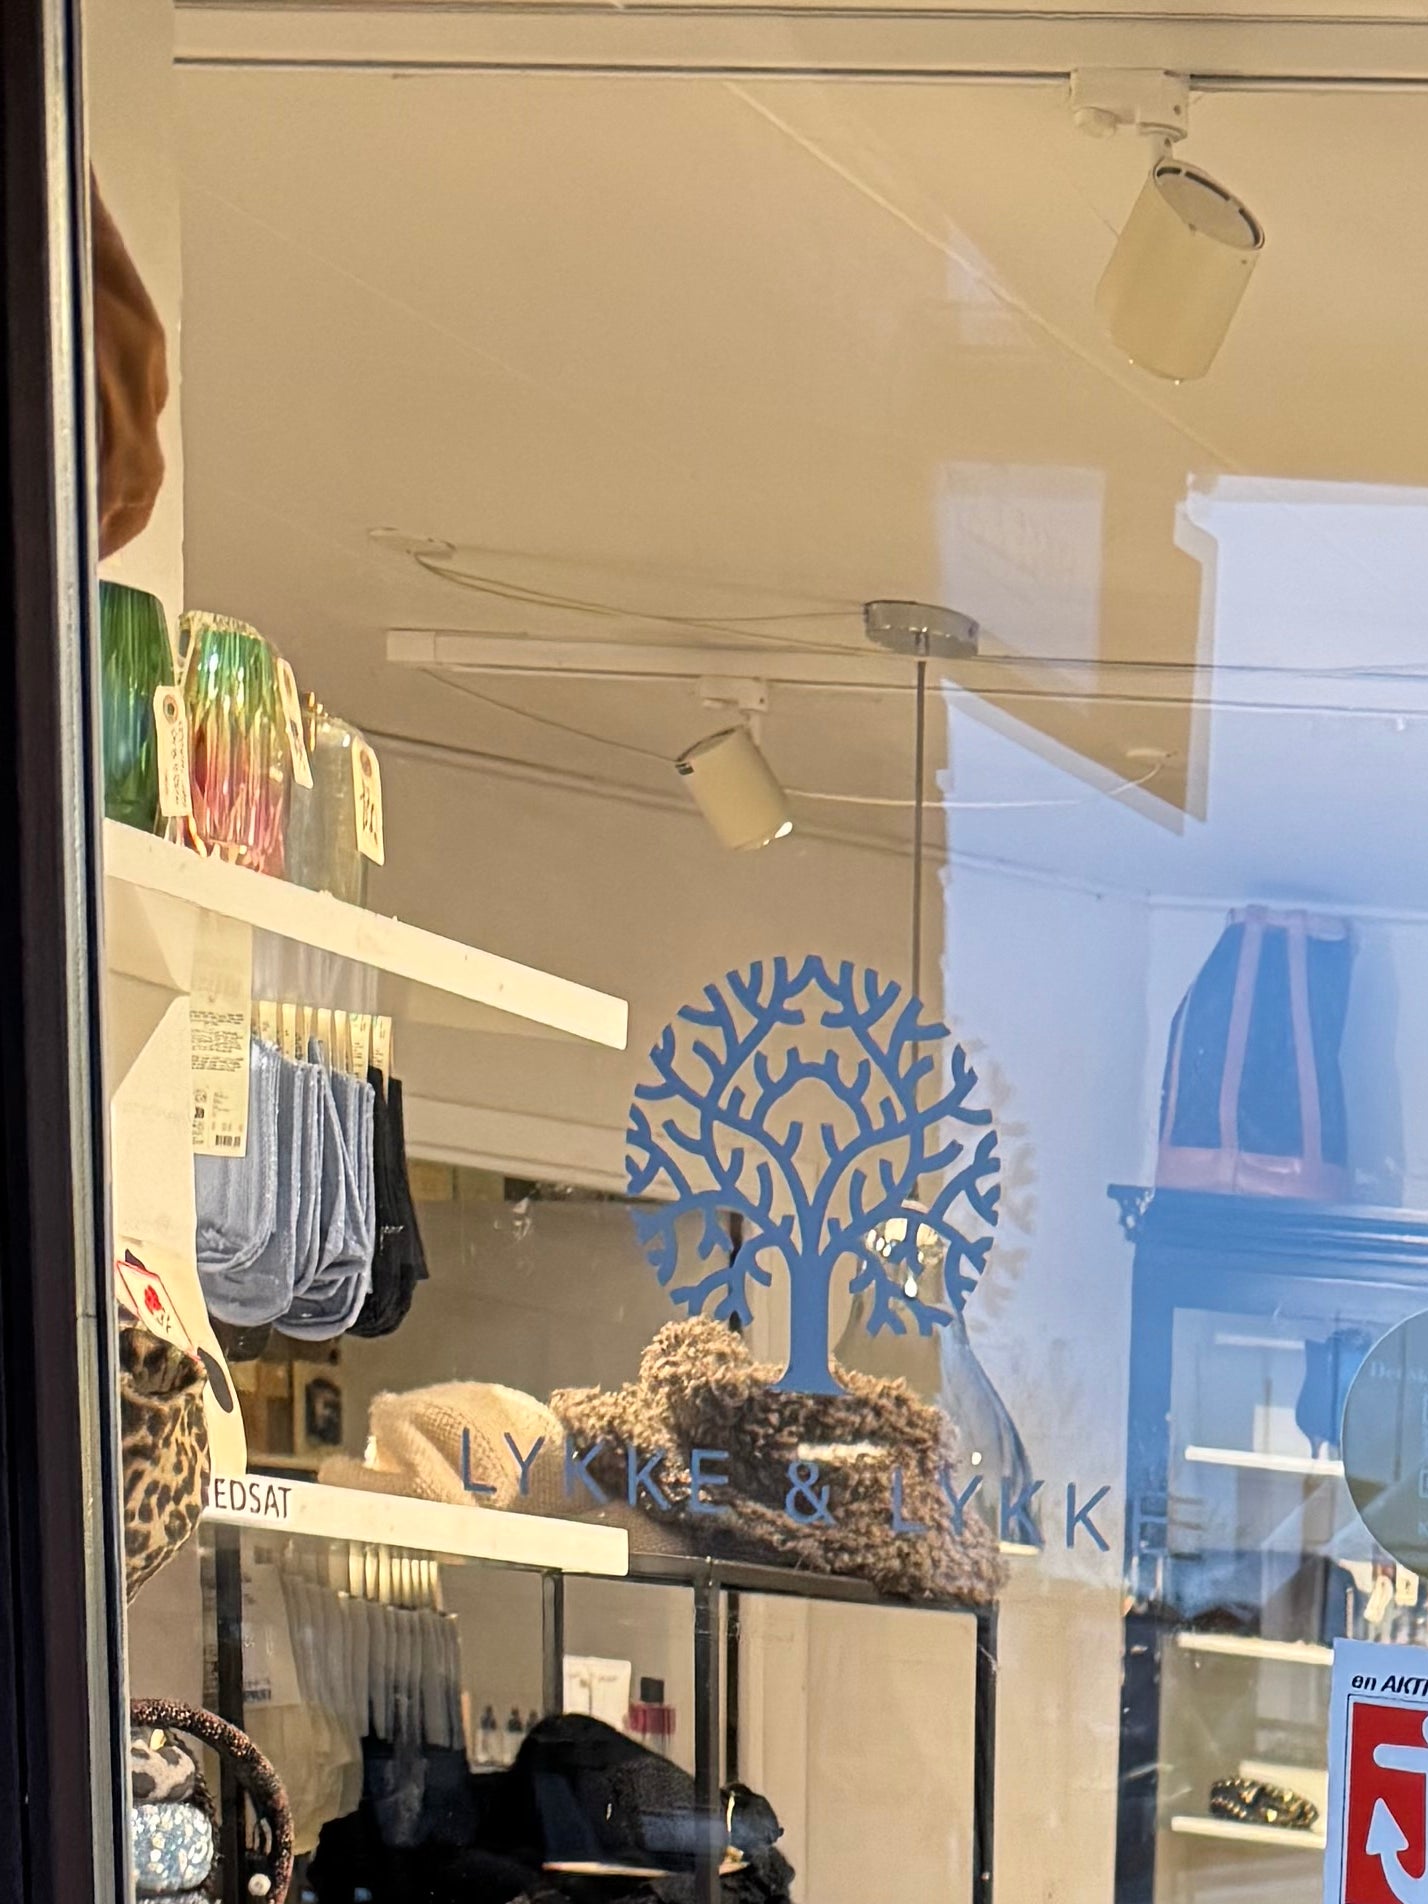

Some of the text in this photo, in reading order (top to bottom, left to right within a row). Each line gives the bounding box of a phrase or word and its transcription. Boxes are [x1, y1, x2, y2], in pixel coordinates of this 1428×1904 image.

[460, 1427, 731, 1516] LYKKE
[785, 1460, 835, 1526] &
[201, 1478, 292, 1520] EDSAT
[1350, 1674, 1378, 1692] en
